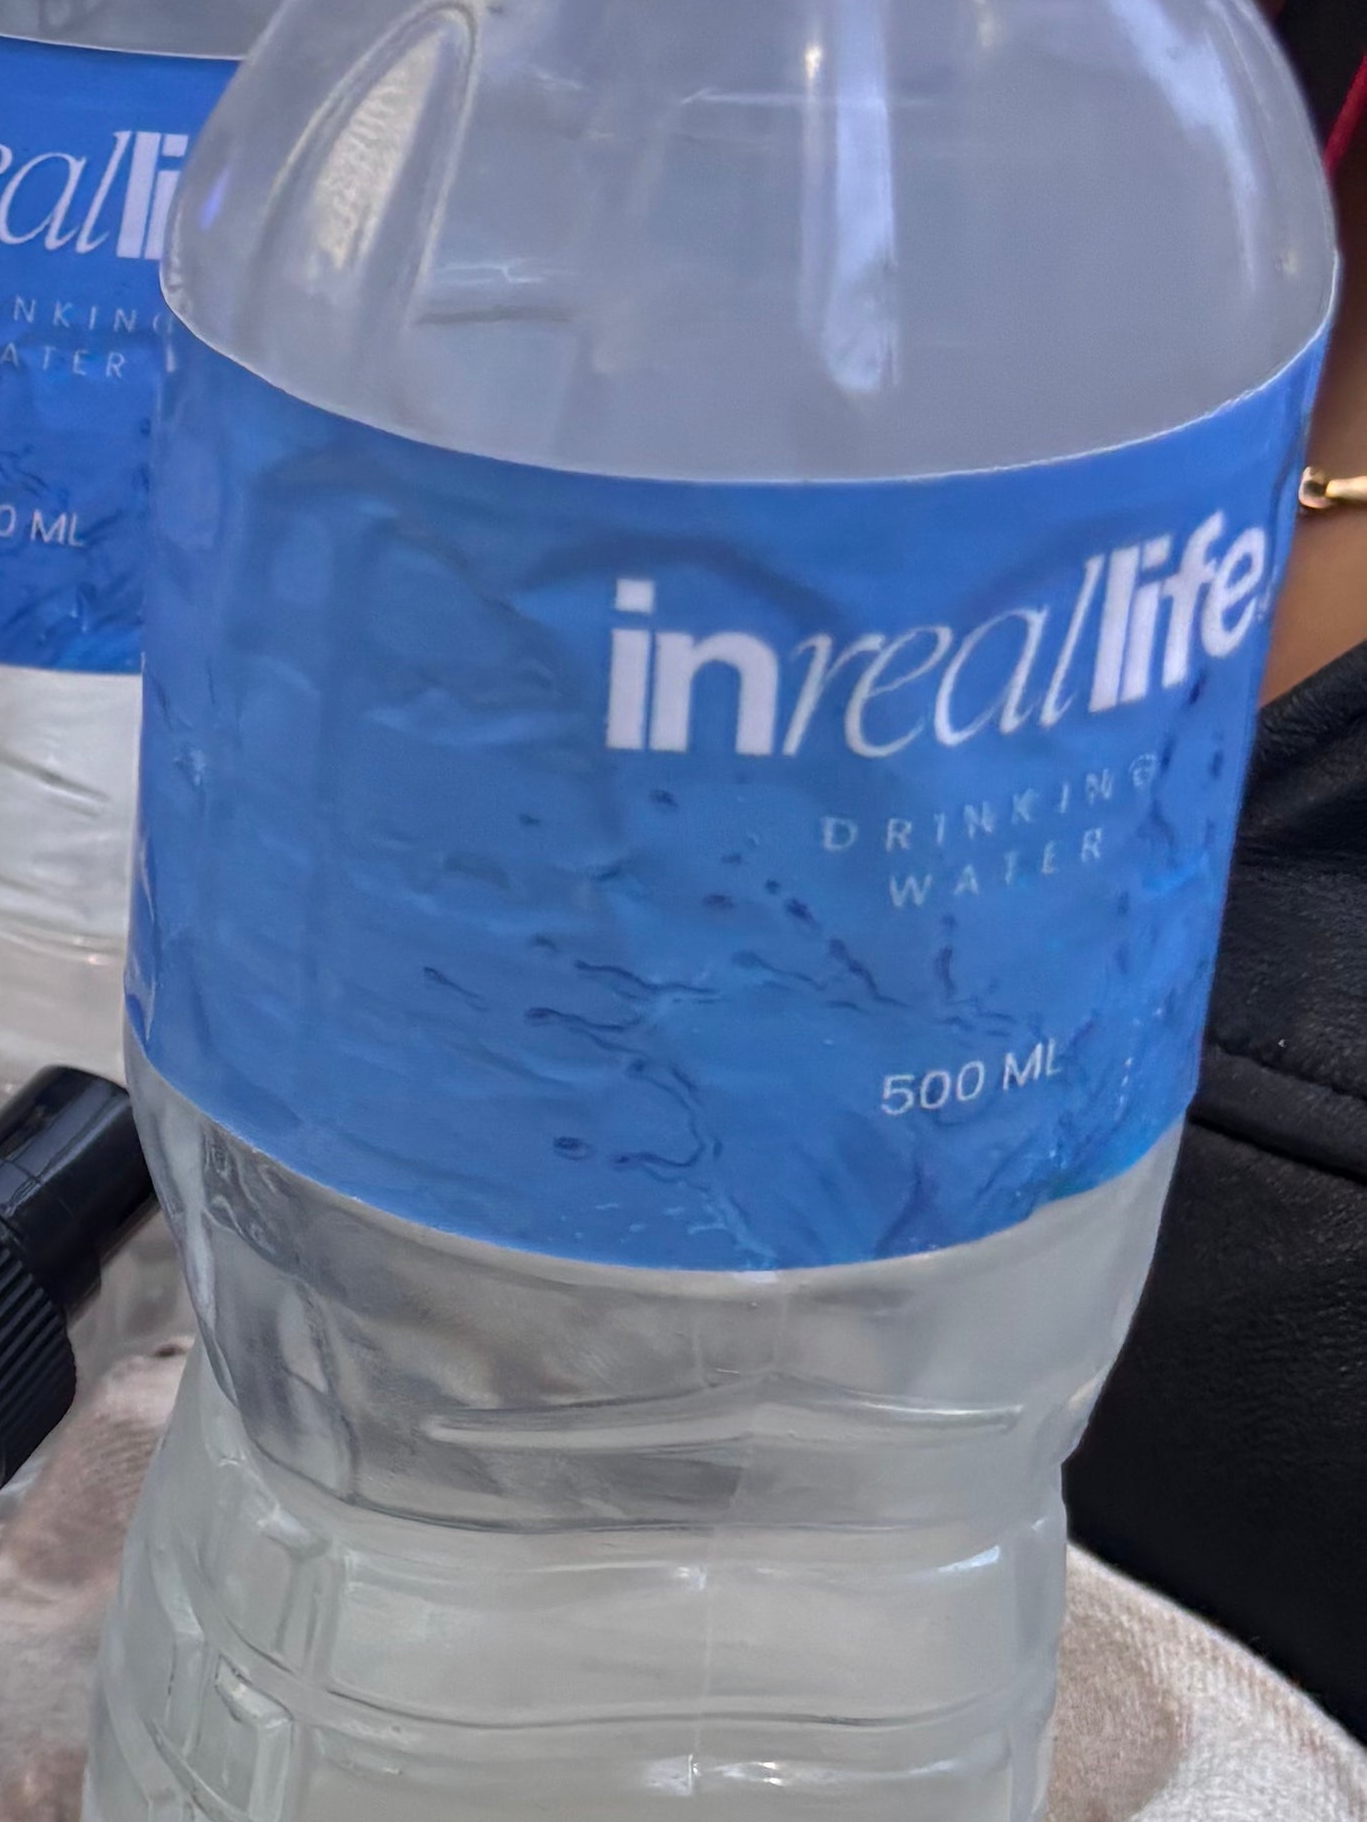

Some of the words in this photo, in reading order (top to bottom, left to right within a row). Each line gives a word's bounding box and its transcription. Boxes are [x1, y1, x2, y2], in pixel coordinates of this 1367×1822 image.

[30, 508, 85, 547] ML
[821, 753, 1159, 852] DRINKING
[889, 826, 1103, 908] WATER
[880, 1060, 985, 1116] 500
[1003, 1037, 1062, 1091] ML
